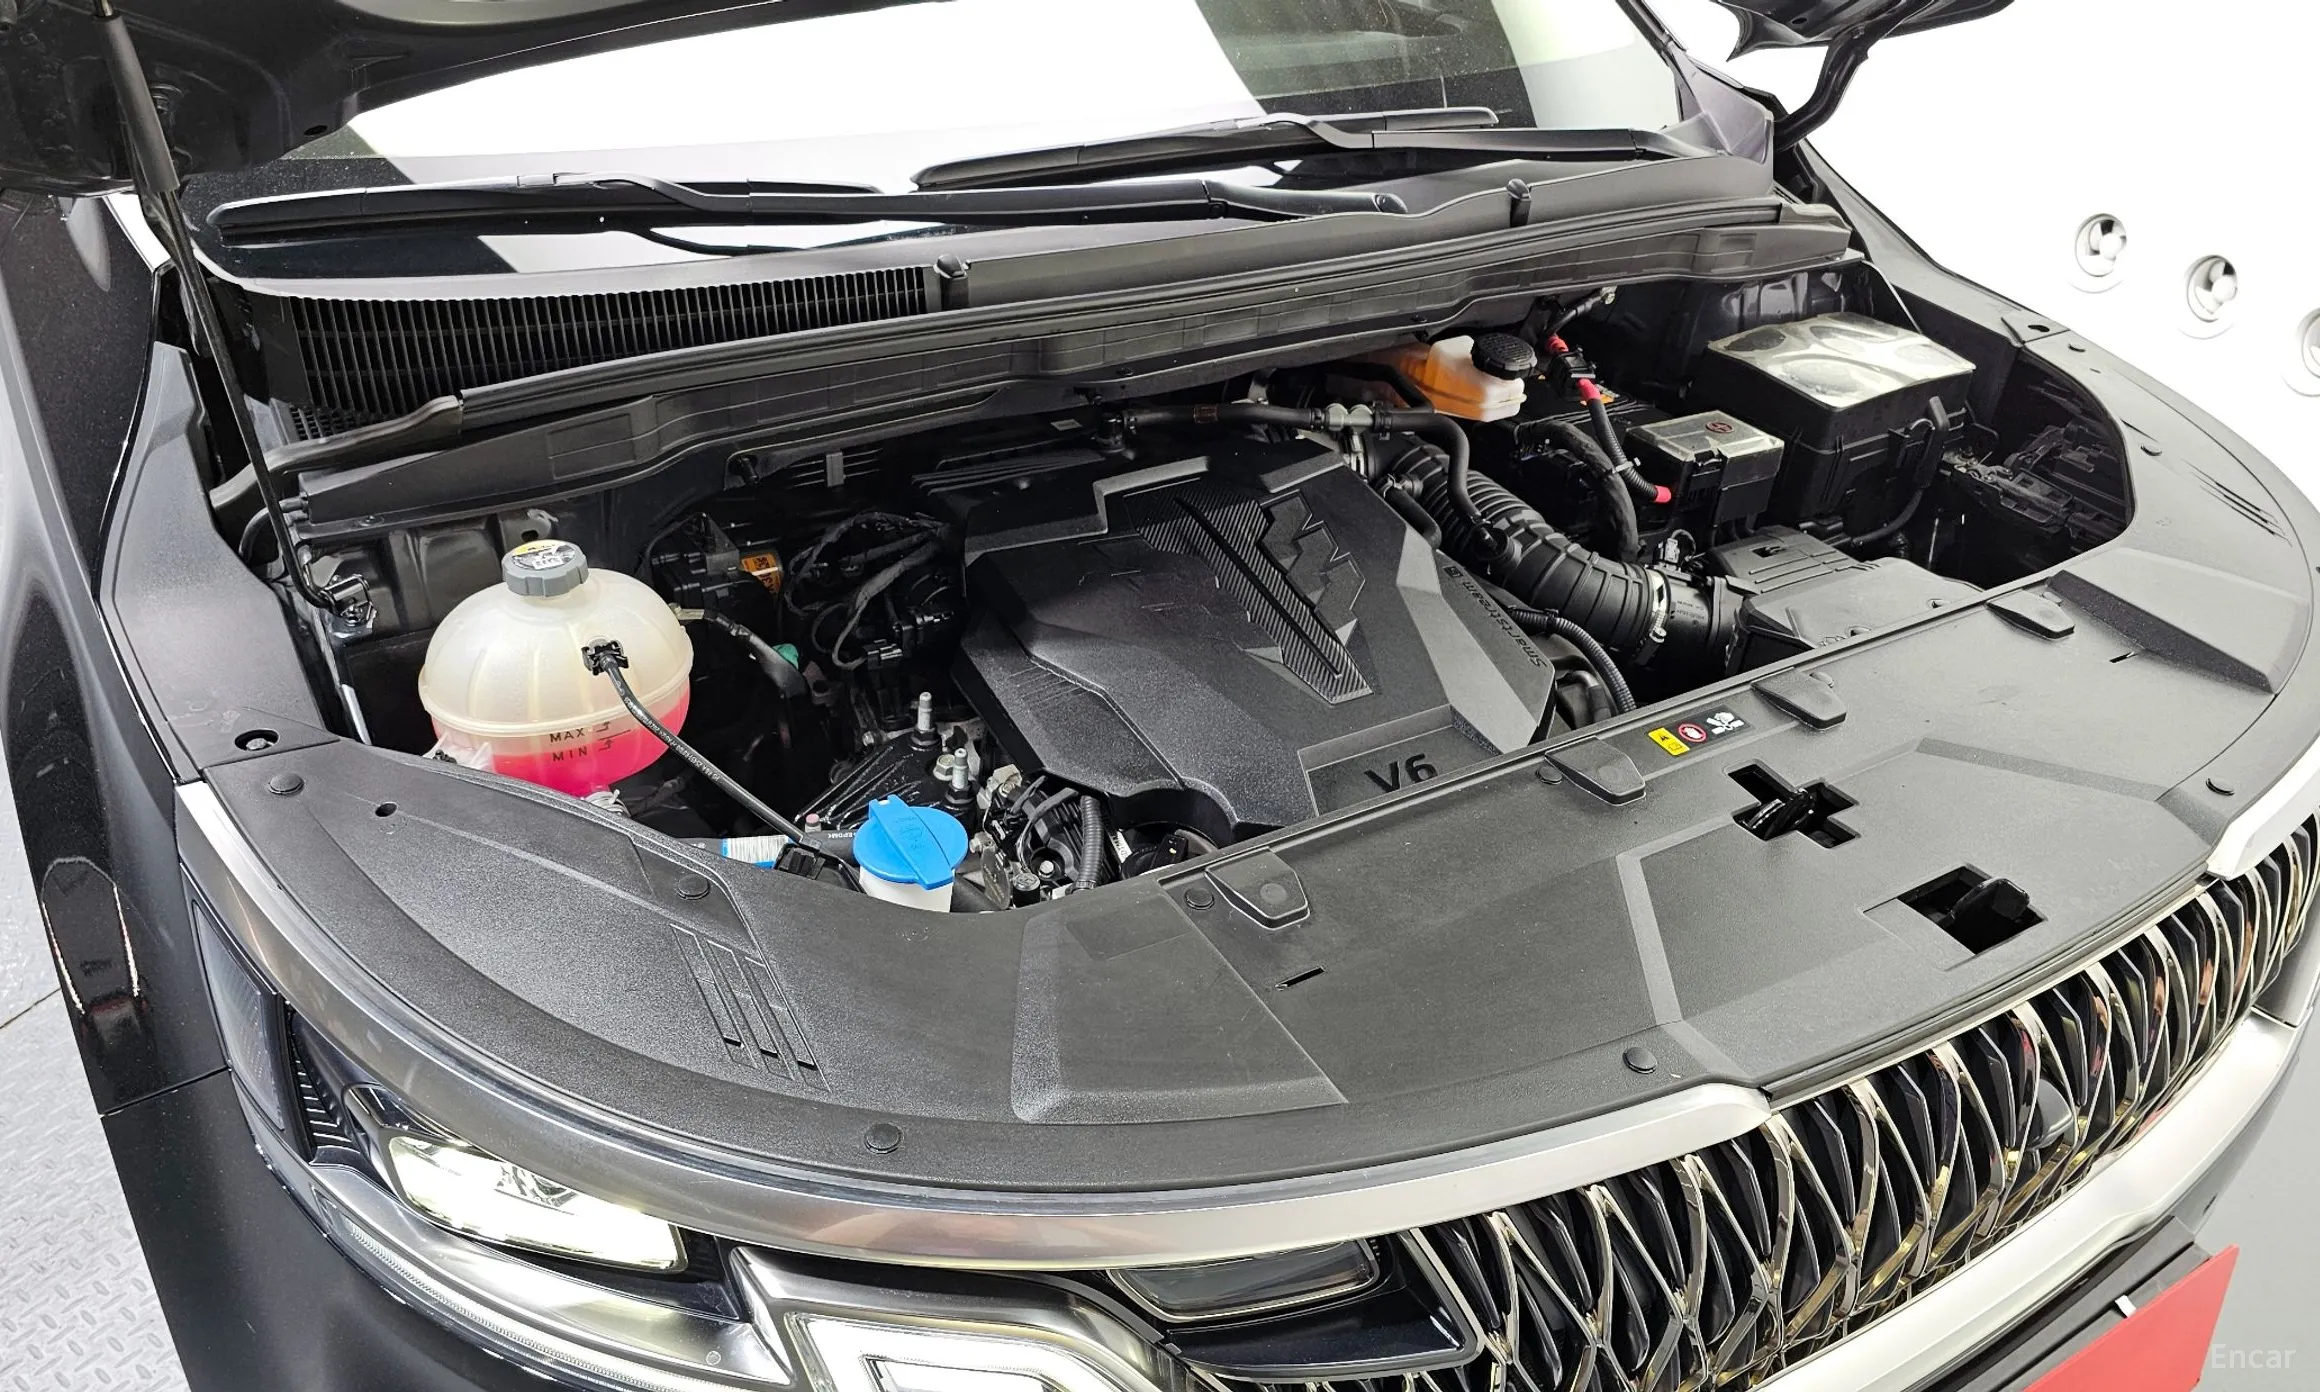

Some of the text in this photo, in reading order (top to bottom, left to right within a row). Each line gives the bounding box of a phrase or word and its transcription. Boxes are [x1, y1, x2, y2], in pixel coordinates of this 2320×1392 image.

[1462, 581, 1548, 668] Smartstream
[549, 728, 585, 742] MAX
[552, 746, 588, 761] MIN
[1364, 753, 1438, 793] V6
